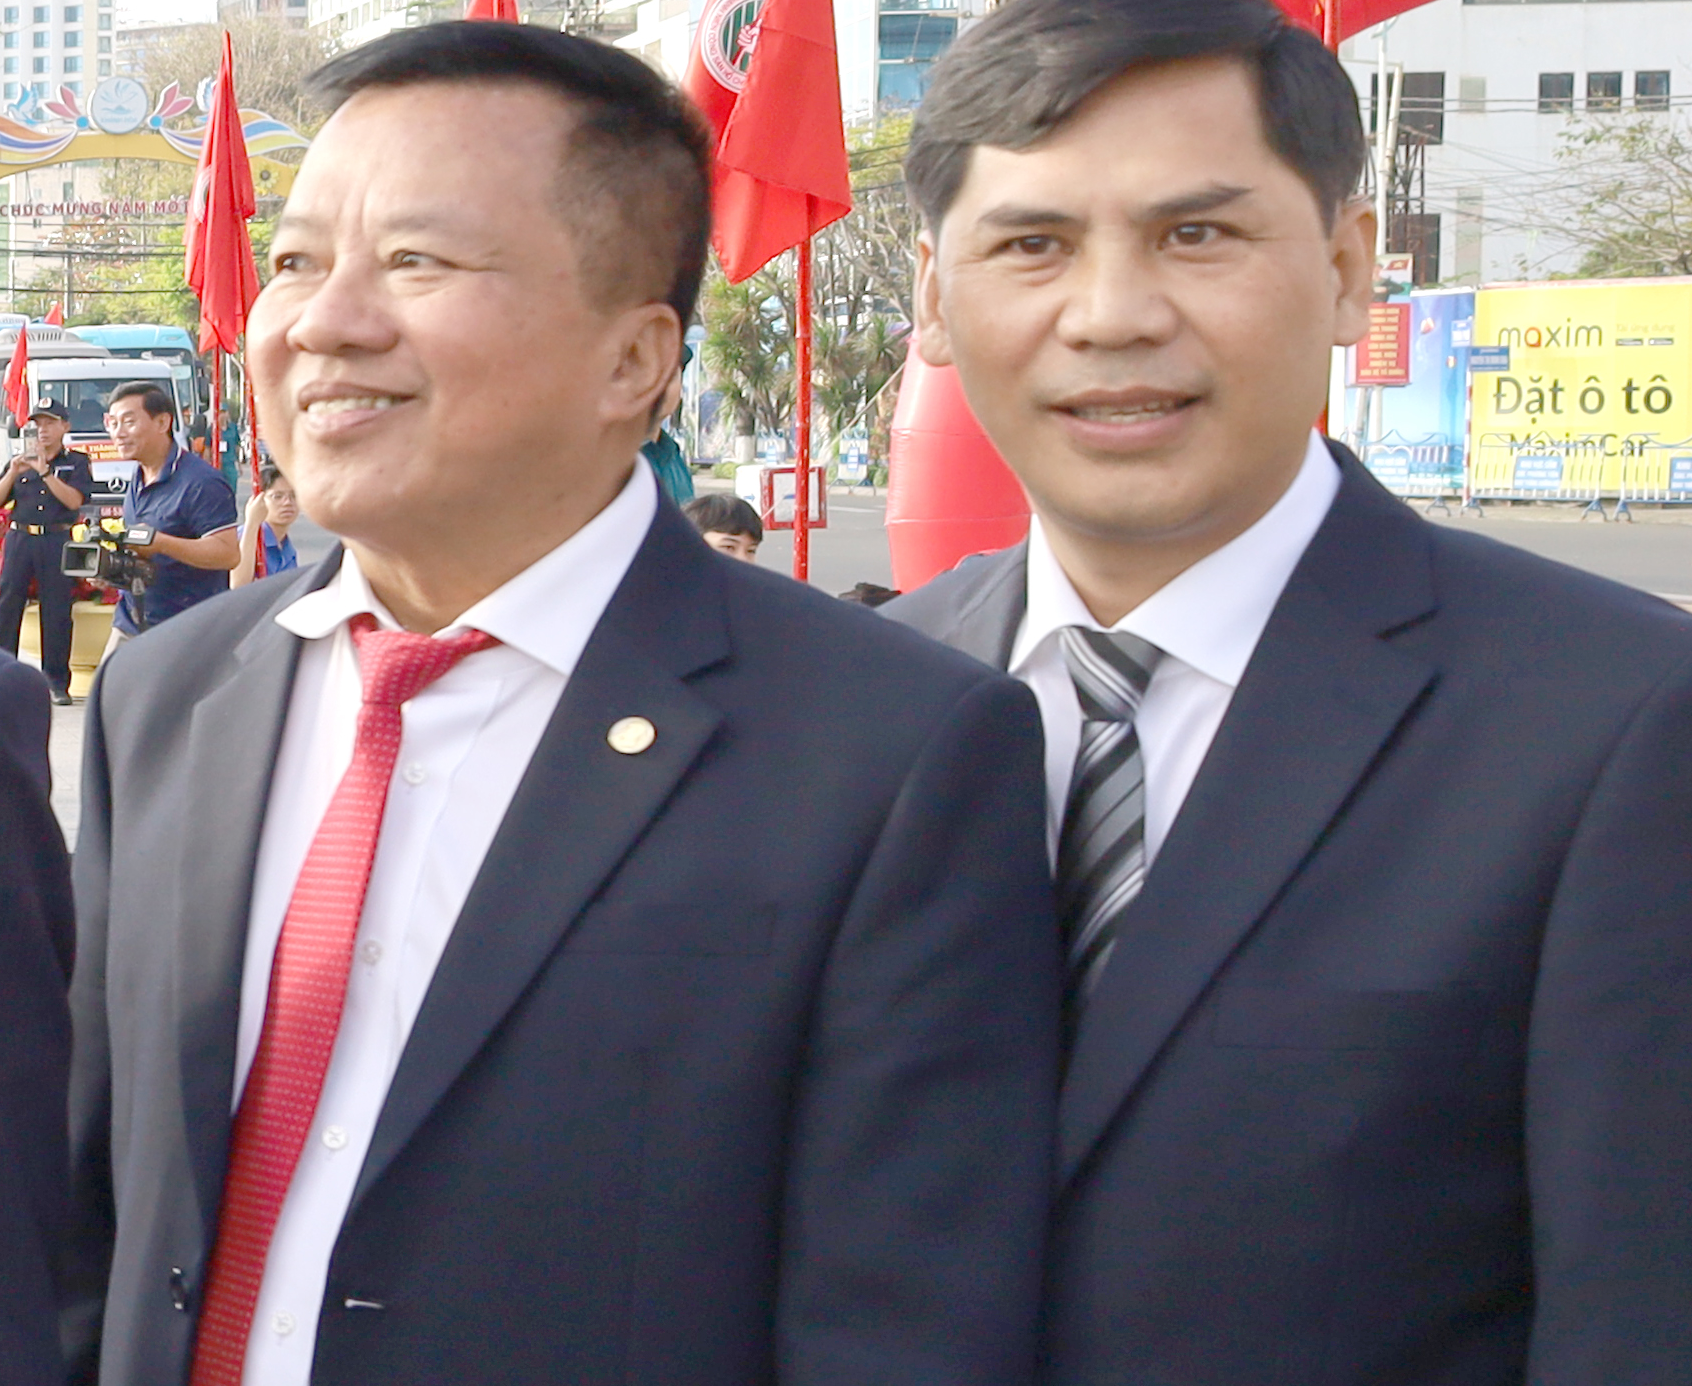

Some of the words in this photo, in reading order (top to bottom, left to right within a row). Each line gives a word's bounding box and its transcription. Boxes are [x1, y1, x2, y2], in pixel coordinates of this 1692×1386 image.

[1498, 318, 1603, 348] maxim
[1493, 375, 1565, 425] Đặt
[1579, 375, 1605, 414] ô
[1622, 374, 1672, 414] tô
